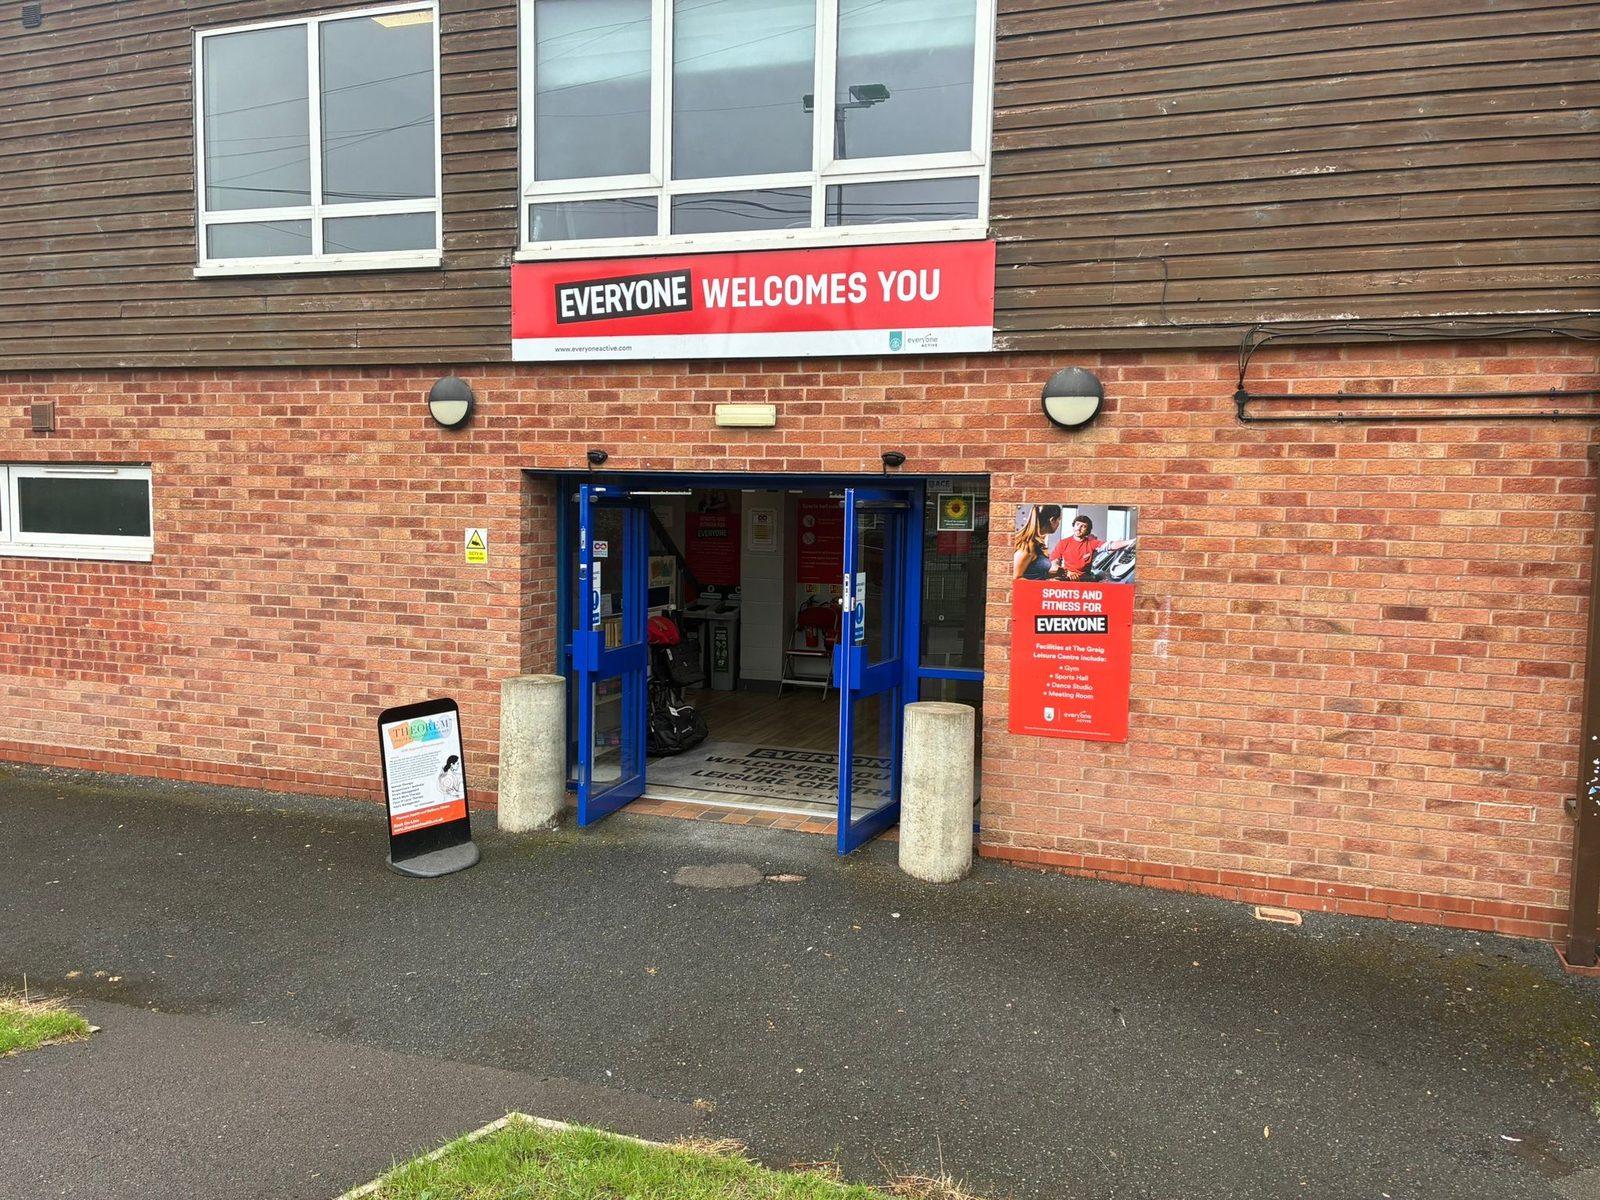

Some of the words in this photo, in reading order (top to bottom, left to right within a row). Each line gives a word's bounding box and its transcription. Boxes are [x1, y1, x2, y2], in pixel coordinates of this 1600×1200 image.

[559, 275, 688, 318] EVERYONE
[701, 271, 868, 309] WELCOMES
[877, 268, 942, 303] YOU
[907, 334, 938, 343] everyone
[554, 344, 633, 354] www.everyoneactive.com
[1042, 588, 1080, 599] SPORTS
[1082, 590, 1103, 601] AND
[1042, 600, 1080, 611] FITNESS
[1083, 602, 1102, 612] FOR
[1036, 617, 1106, 632] EVERYONE
[1035, 642, 1064, 651] Facilities
[1086, 646, 1105, 654] Greig
[1033, 651, 1057, 660] Leisure
[1057, 652, 1080, 661] Centre
[1054, 673, 1075, 682] Sports
[1076, 674, 1089, 682] Hall
[1051, 681, 1072, 689] Dance
[1072, 682, 1093, 691] Studio
[1048, 690, 1075, 699] Meeting
[1075, 692, 1094, 700] Room
[1063, 710, 1092, 719] everyone
[392, 719, 450, 738] THEOREM
[704, 755, 836, 774] WELCOMES
[742, 765, 788, 777] THE
[690, 769, 792, 786] LEISURE
